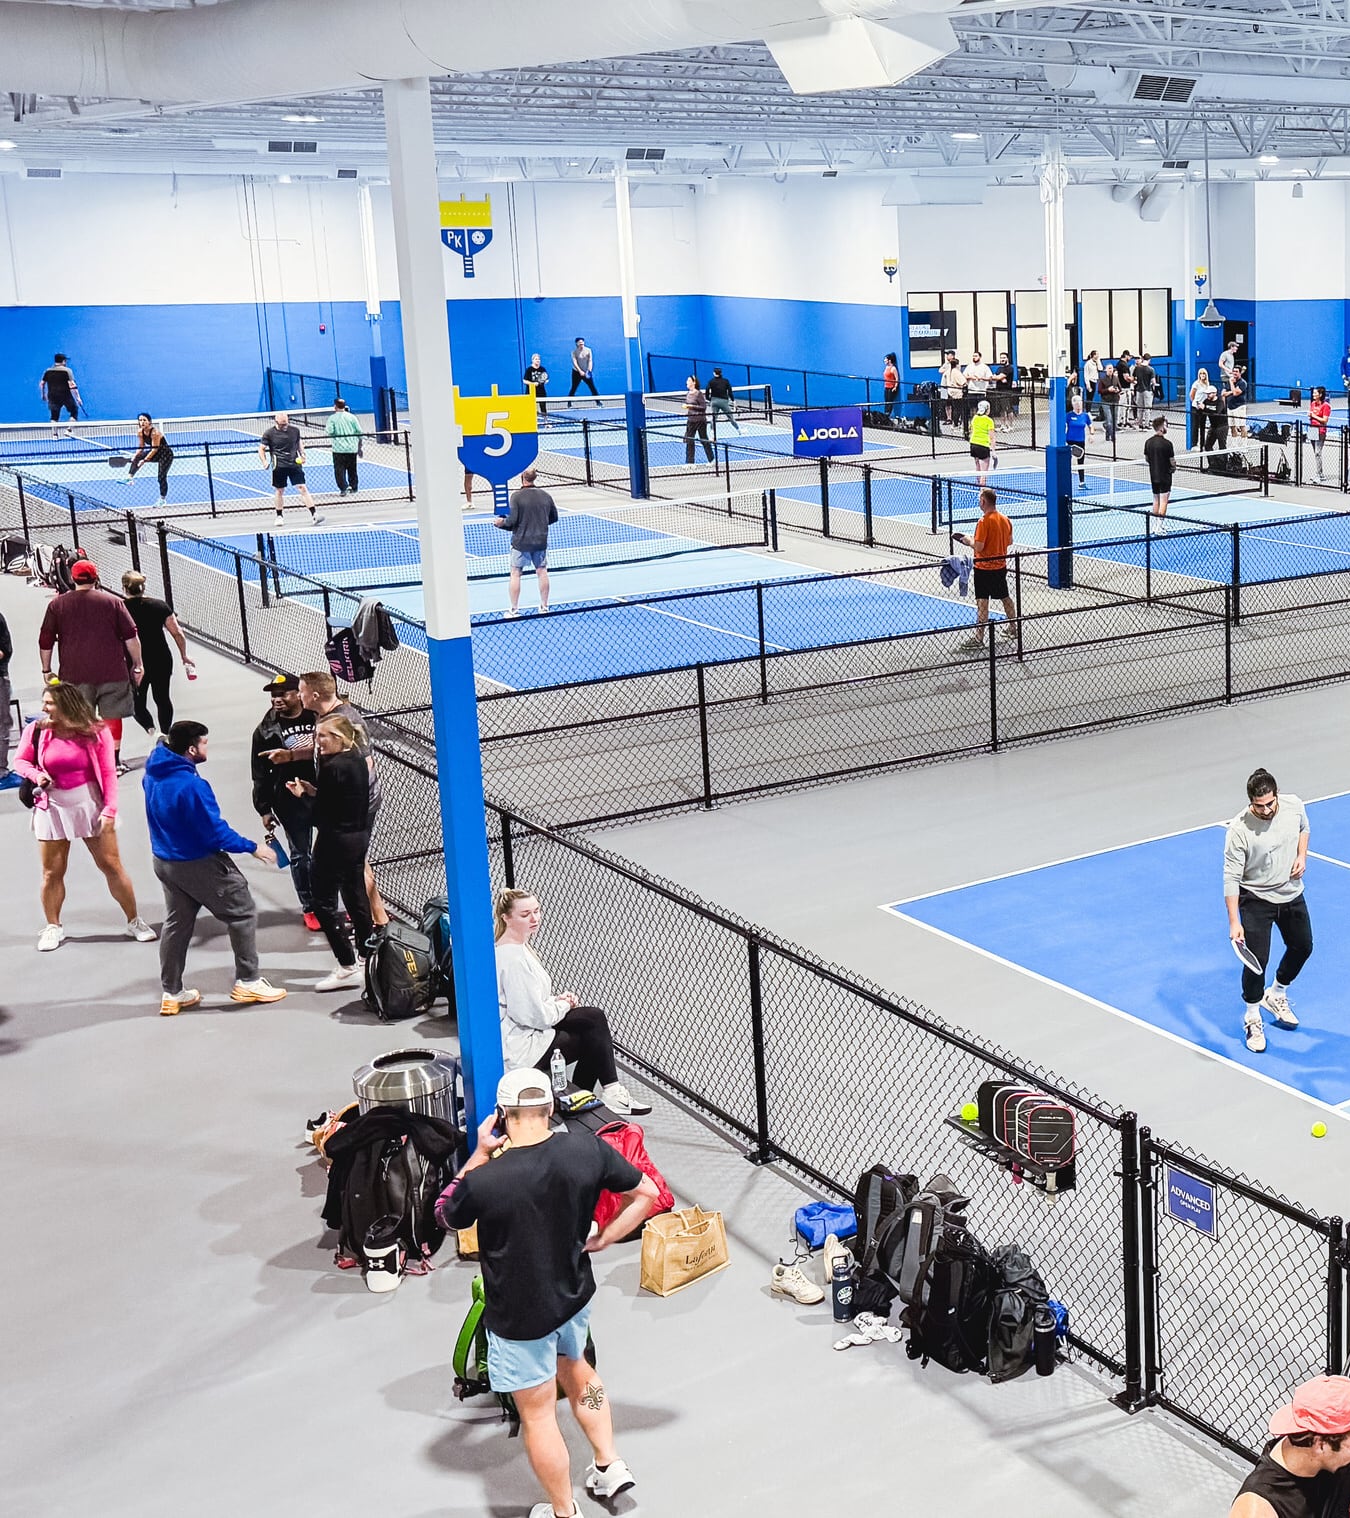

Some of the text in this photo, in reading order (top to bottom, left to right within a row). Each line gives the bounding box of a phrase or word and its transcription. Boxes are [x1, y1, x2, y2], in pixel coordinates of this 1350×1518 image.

[446, 230, 463, 249] PK
[483, 411, 512, 457] 5
[810, 427, 859, 441] JOOLA
[1170, 1184, 1211, 1211] ADVANCED
